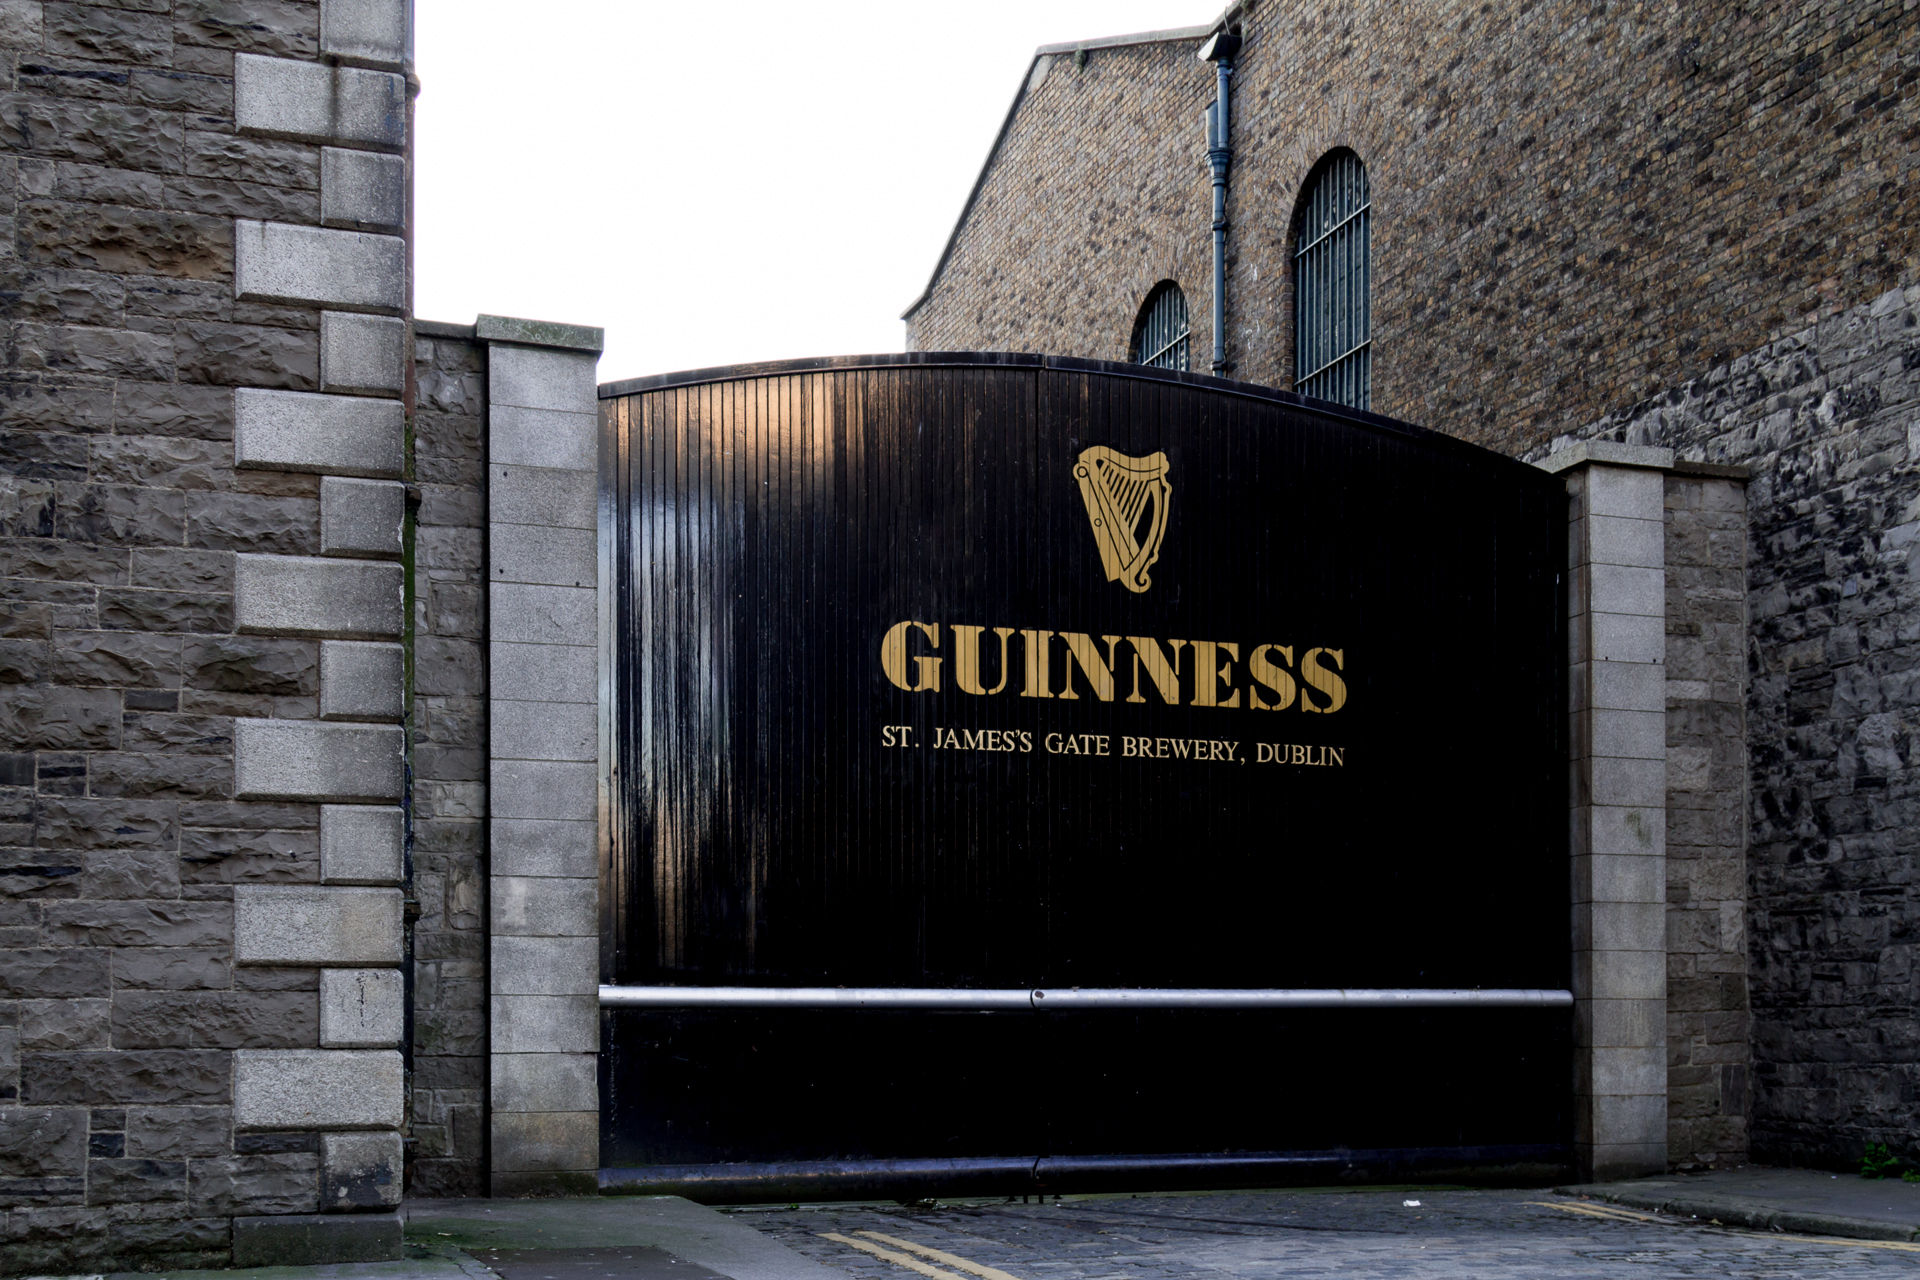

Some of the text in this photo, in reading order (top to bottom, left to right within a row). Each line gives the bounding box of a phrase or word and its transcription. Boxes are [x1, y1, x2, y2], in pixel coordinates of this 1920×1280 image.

[881, 619, 1348, 714] GUINNESS
[881, 725, 920, 748] ST.
[1044, 732, 1110, 756] GATE
[1121, 735, 1246, 766] BREWERY,
[1256, 742, 1346, 768] DUBLIN
